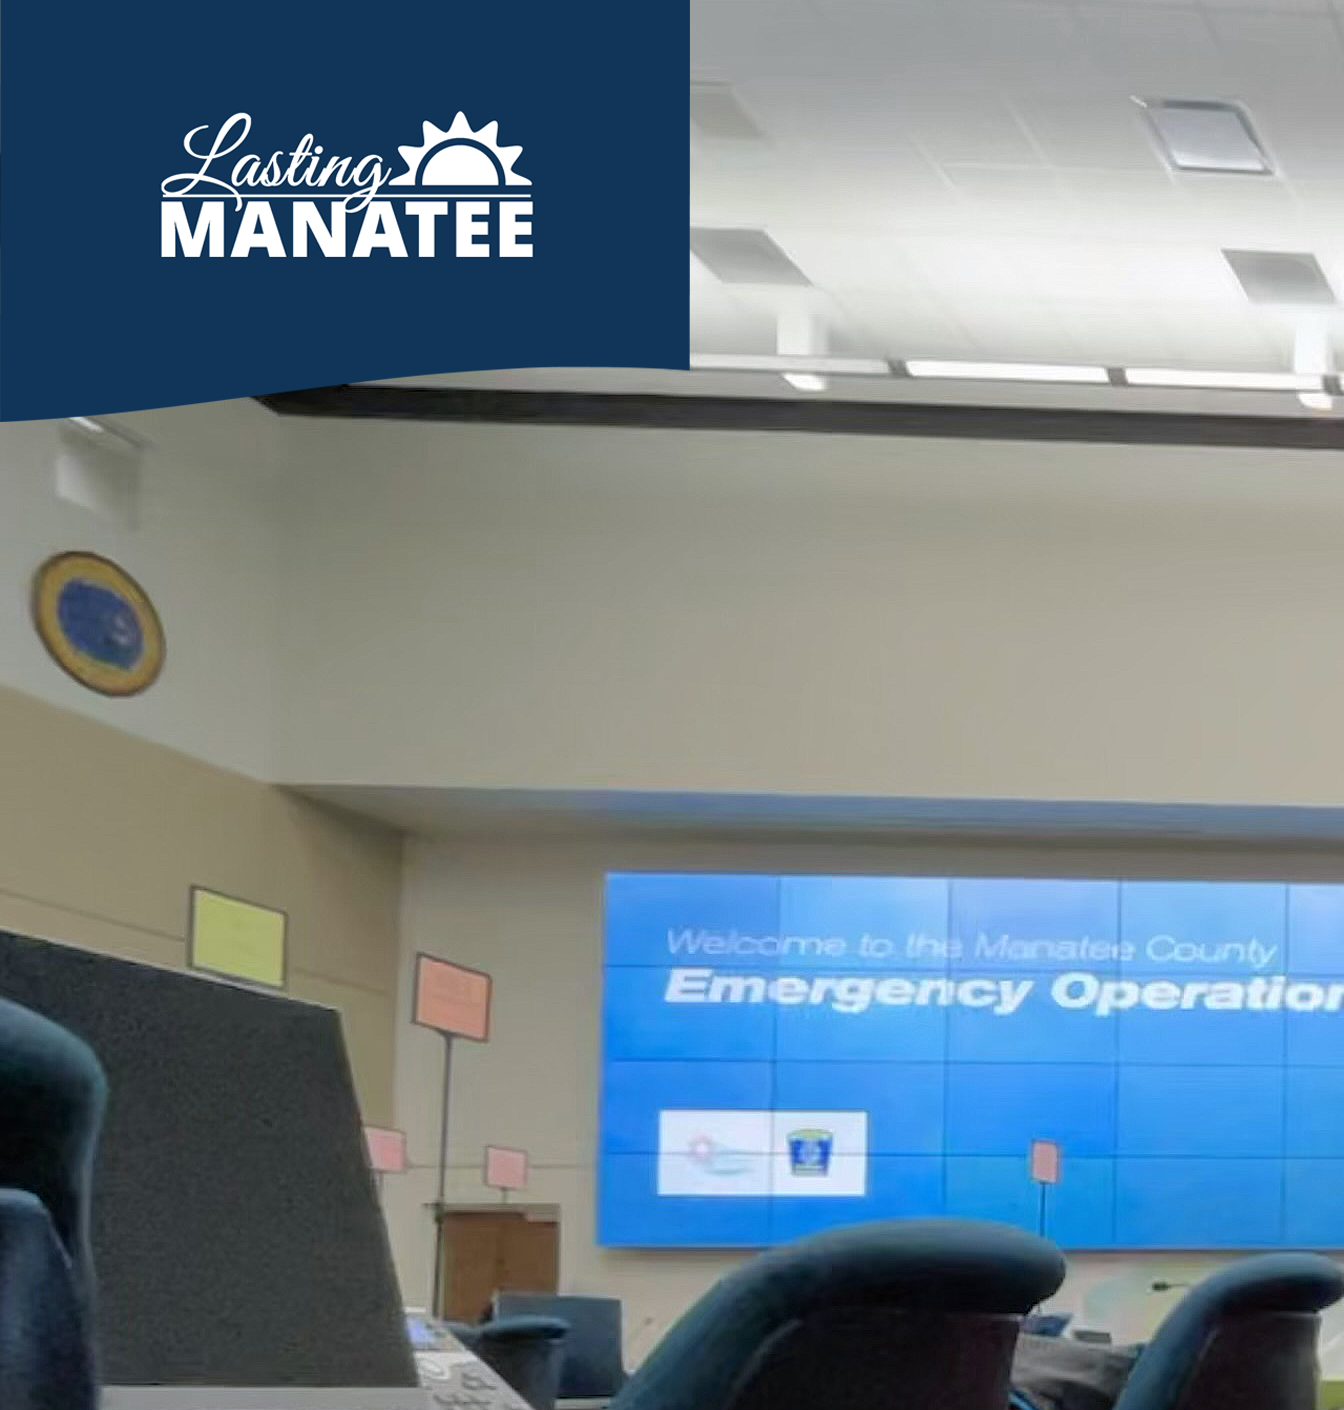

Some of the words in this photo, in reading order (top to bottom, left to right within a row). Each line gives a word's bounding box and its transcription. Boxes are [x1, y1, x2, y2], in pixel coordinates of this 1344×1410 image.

[667, 927, 847, 956] Welcome
[858, 933, 894, 959] to
[906, 933, 963, 960] the
[974, 934, 1136, 961] Manatee
[1146, 934, 1278, 968] County
[665, 968, 1034, 1015] Emergency
